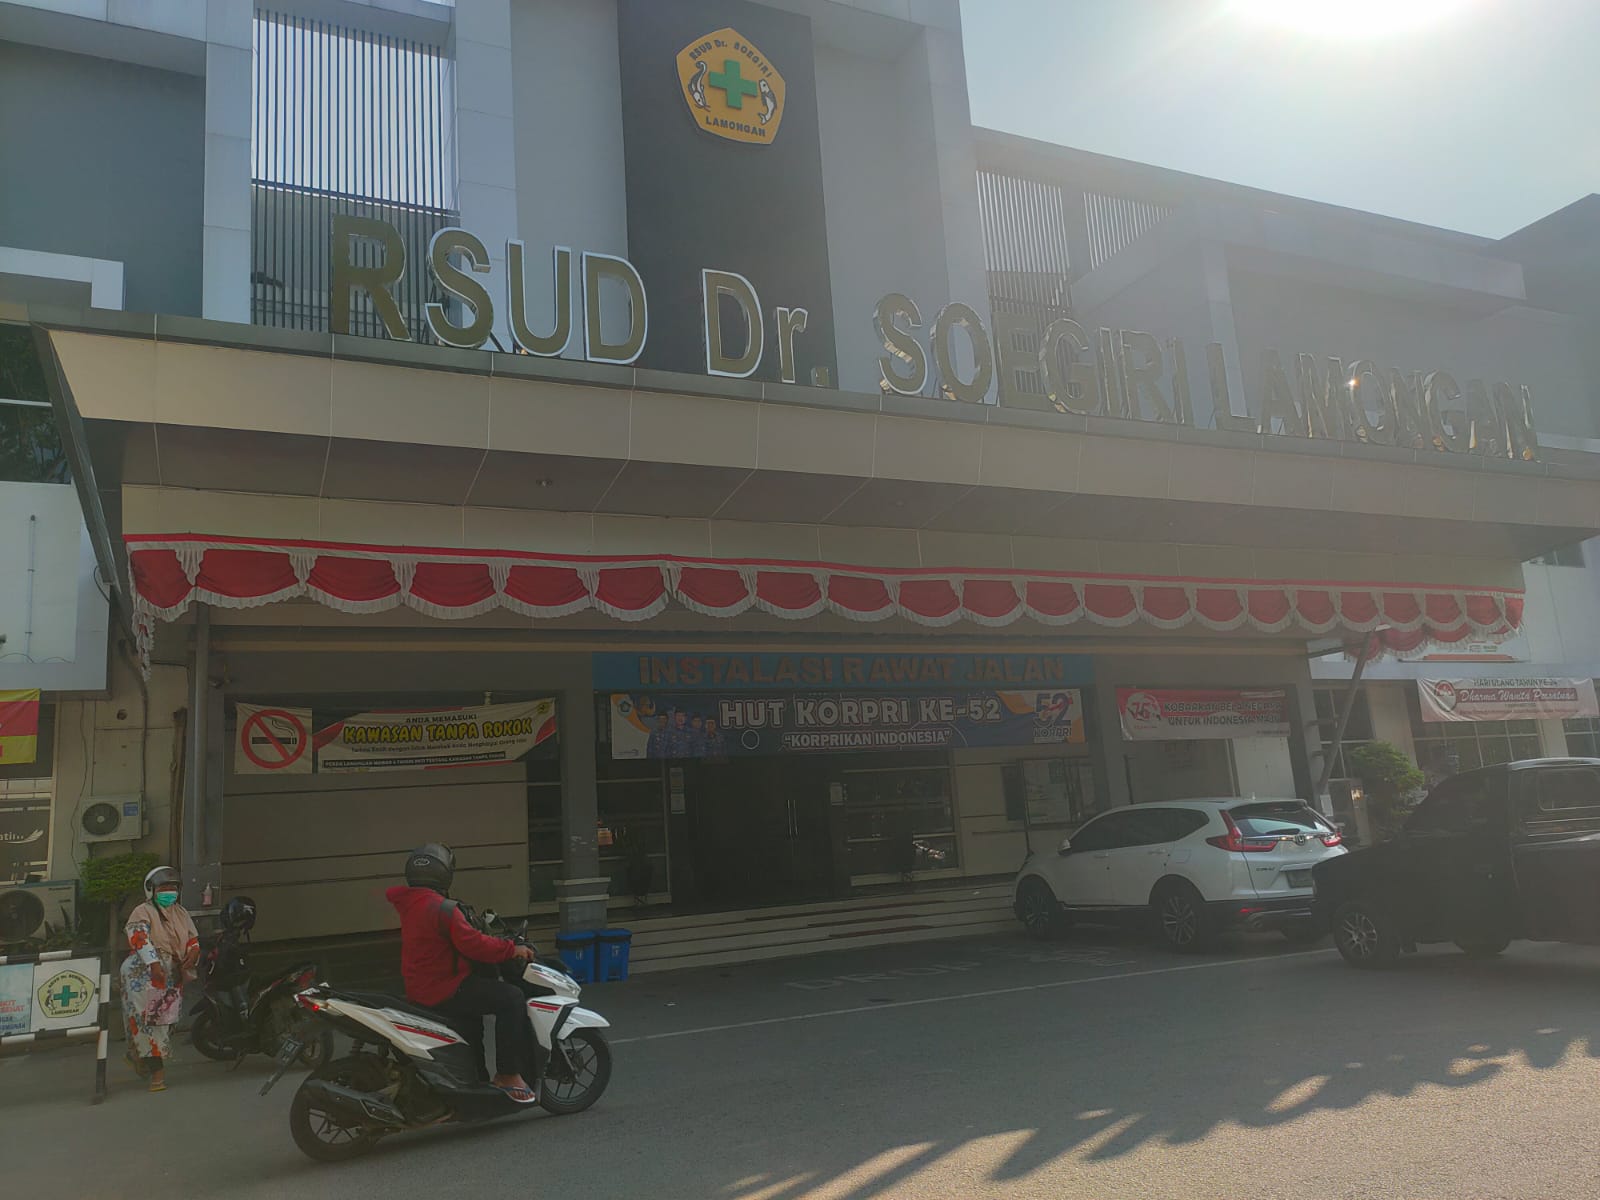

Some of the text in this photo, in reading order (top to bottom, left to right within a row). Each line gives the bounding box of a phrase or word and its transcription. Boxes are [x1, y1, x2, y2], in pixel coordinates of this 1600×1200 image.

[705, 116, 766, 137] LAMONGAN
[330, 215, 1541, 463] RSUD Dr. SOEGIRI LAMONGAN
[639, 656, 1065, 686] INSTALASI RAWAT JALAN
[1459, 689, 1497, 702] Dharma
[1498, 689, 1530, 701] Wanita
[406, 713, 477, 724] ANDA MEMASUKI
[719, 696, 1003, 729] HUT KORPRI KE-52
[1034, 693, 1073, 727] 52
[1168, 716, 1202, 726] UNTUK
[1203, 715, 1253, 726] INDONESIA
[344, 717, 533, 744] KAWASAN TANPA ROKOK
